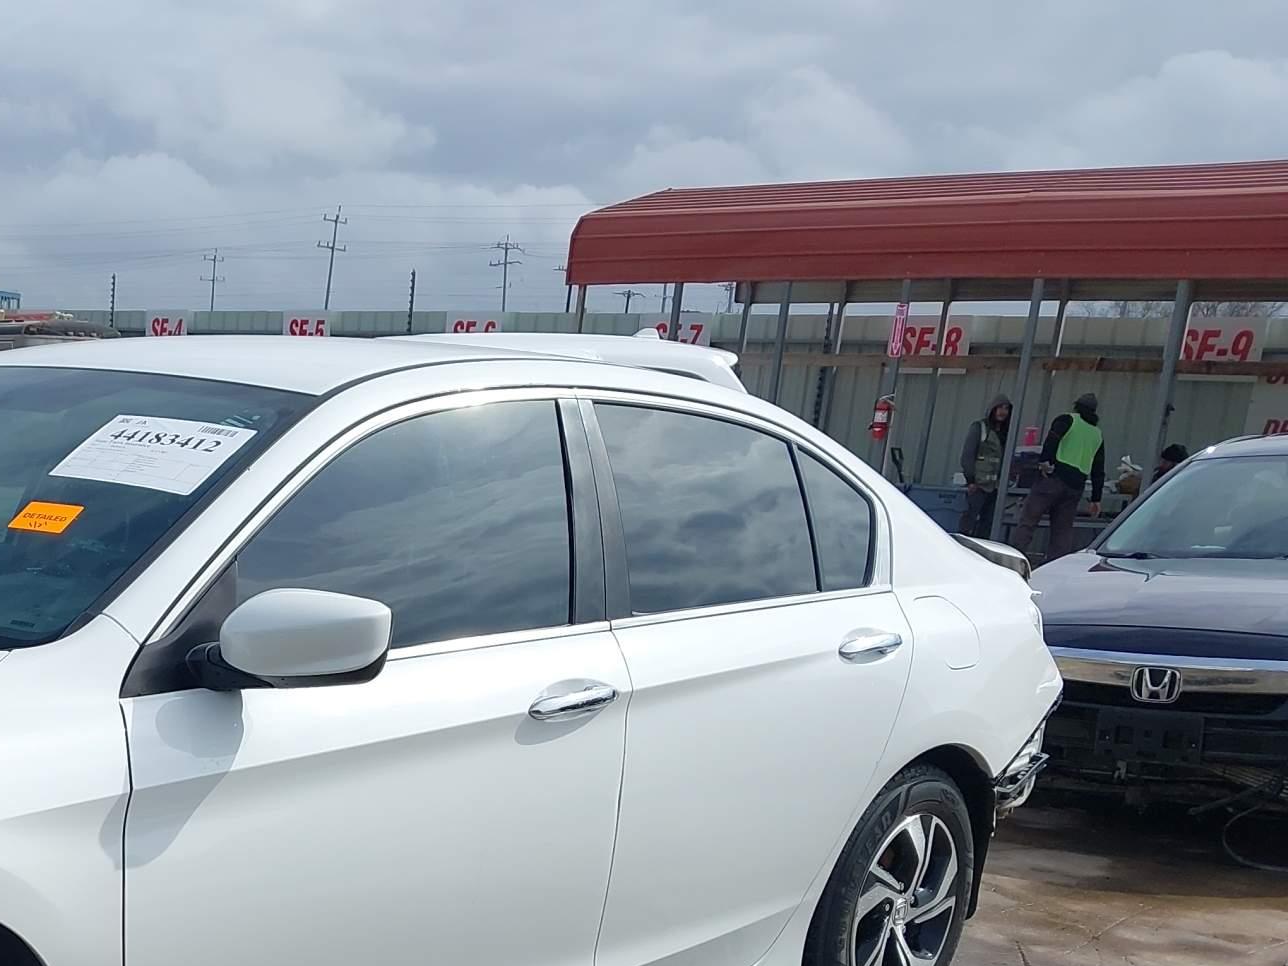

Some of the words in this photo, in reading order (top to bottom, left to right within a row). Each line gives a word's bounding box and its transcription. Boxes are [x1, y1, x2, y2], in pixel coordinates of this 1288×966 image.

[151, 317, 184, 337] SF-4
[902, 326, 963, 356] SF-8
[1182, 328, 1255, 362] SF-9
[109, 428, 223, 453] 44183412
[22, 512, 68, 522] DETAILED
